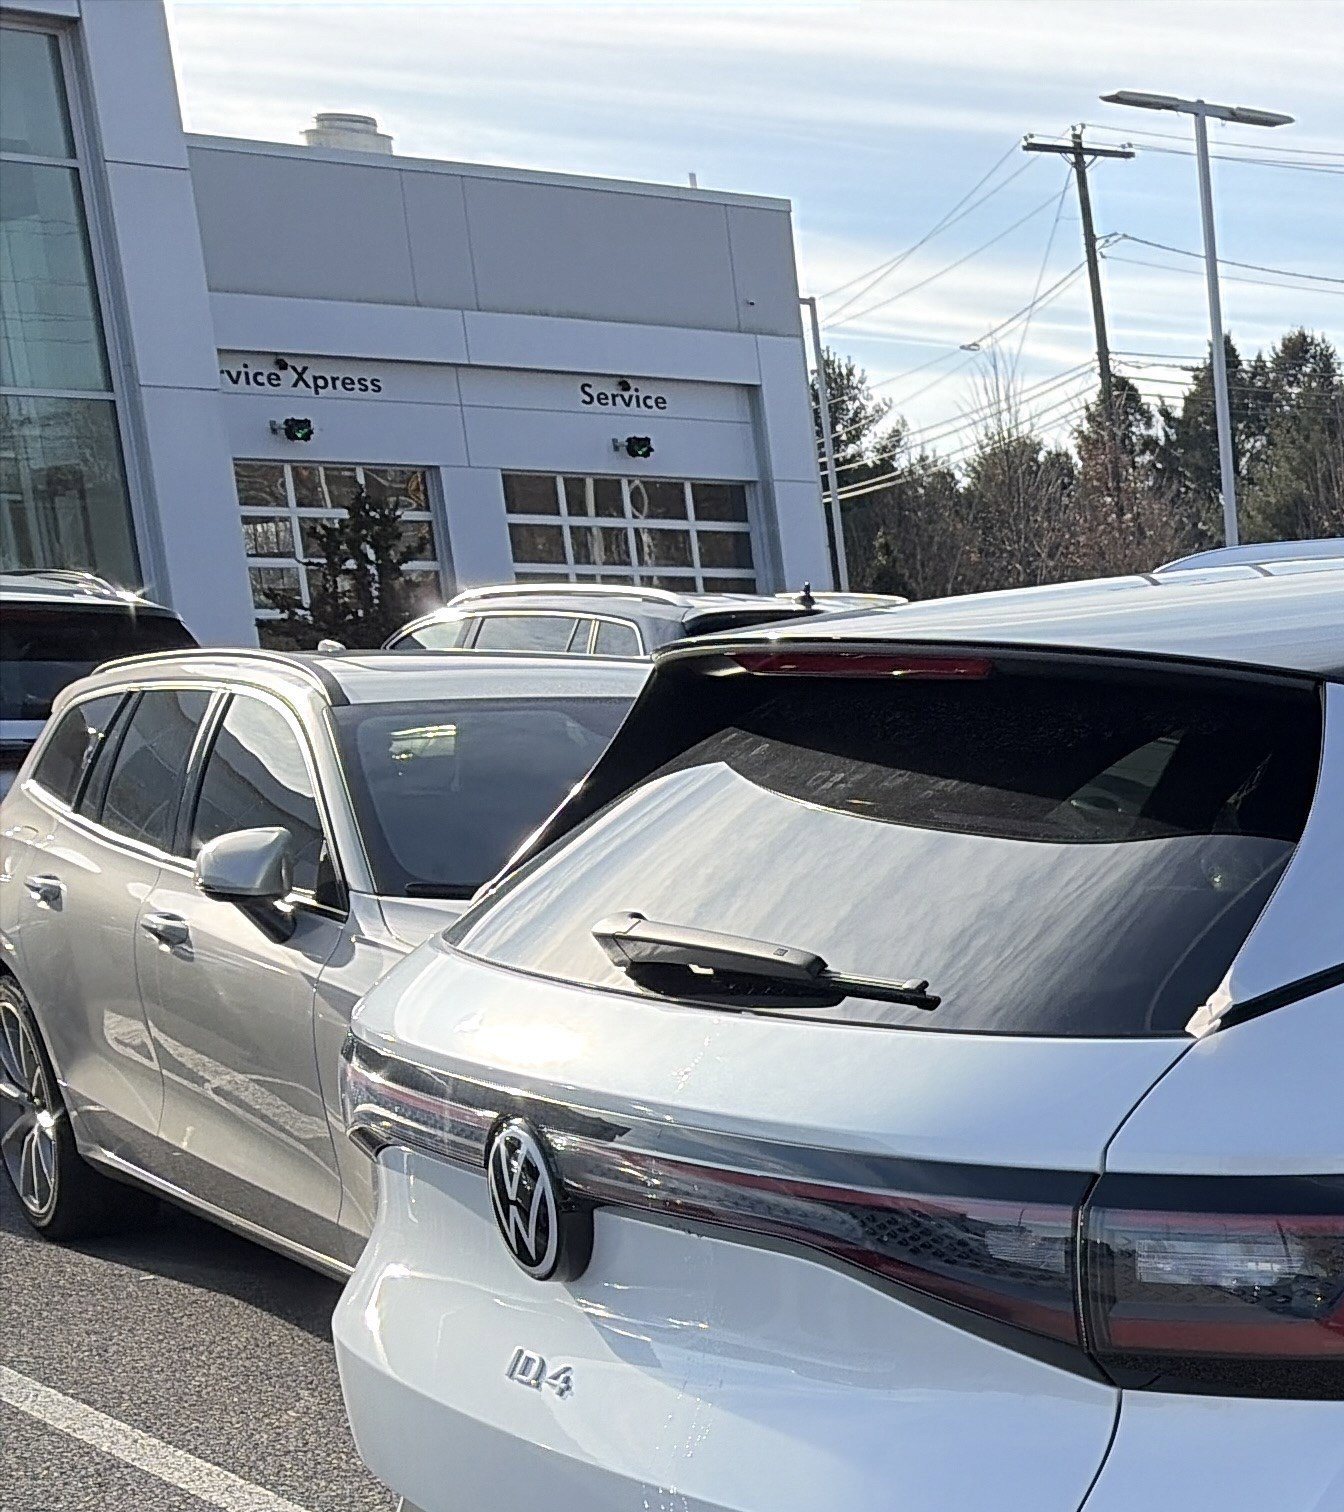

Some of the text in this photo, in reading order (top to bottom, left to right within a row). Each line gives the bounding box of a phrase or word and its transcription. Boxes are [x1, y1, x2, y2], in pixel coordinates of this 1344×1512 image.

[219, 363, 383, 396] vice Xpress
[580, 382, 668, 411] Service
